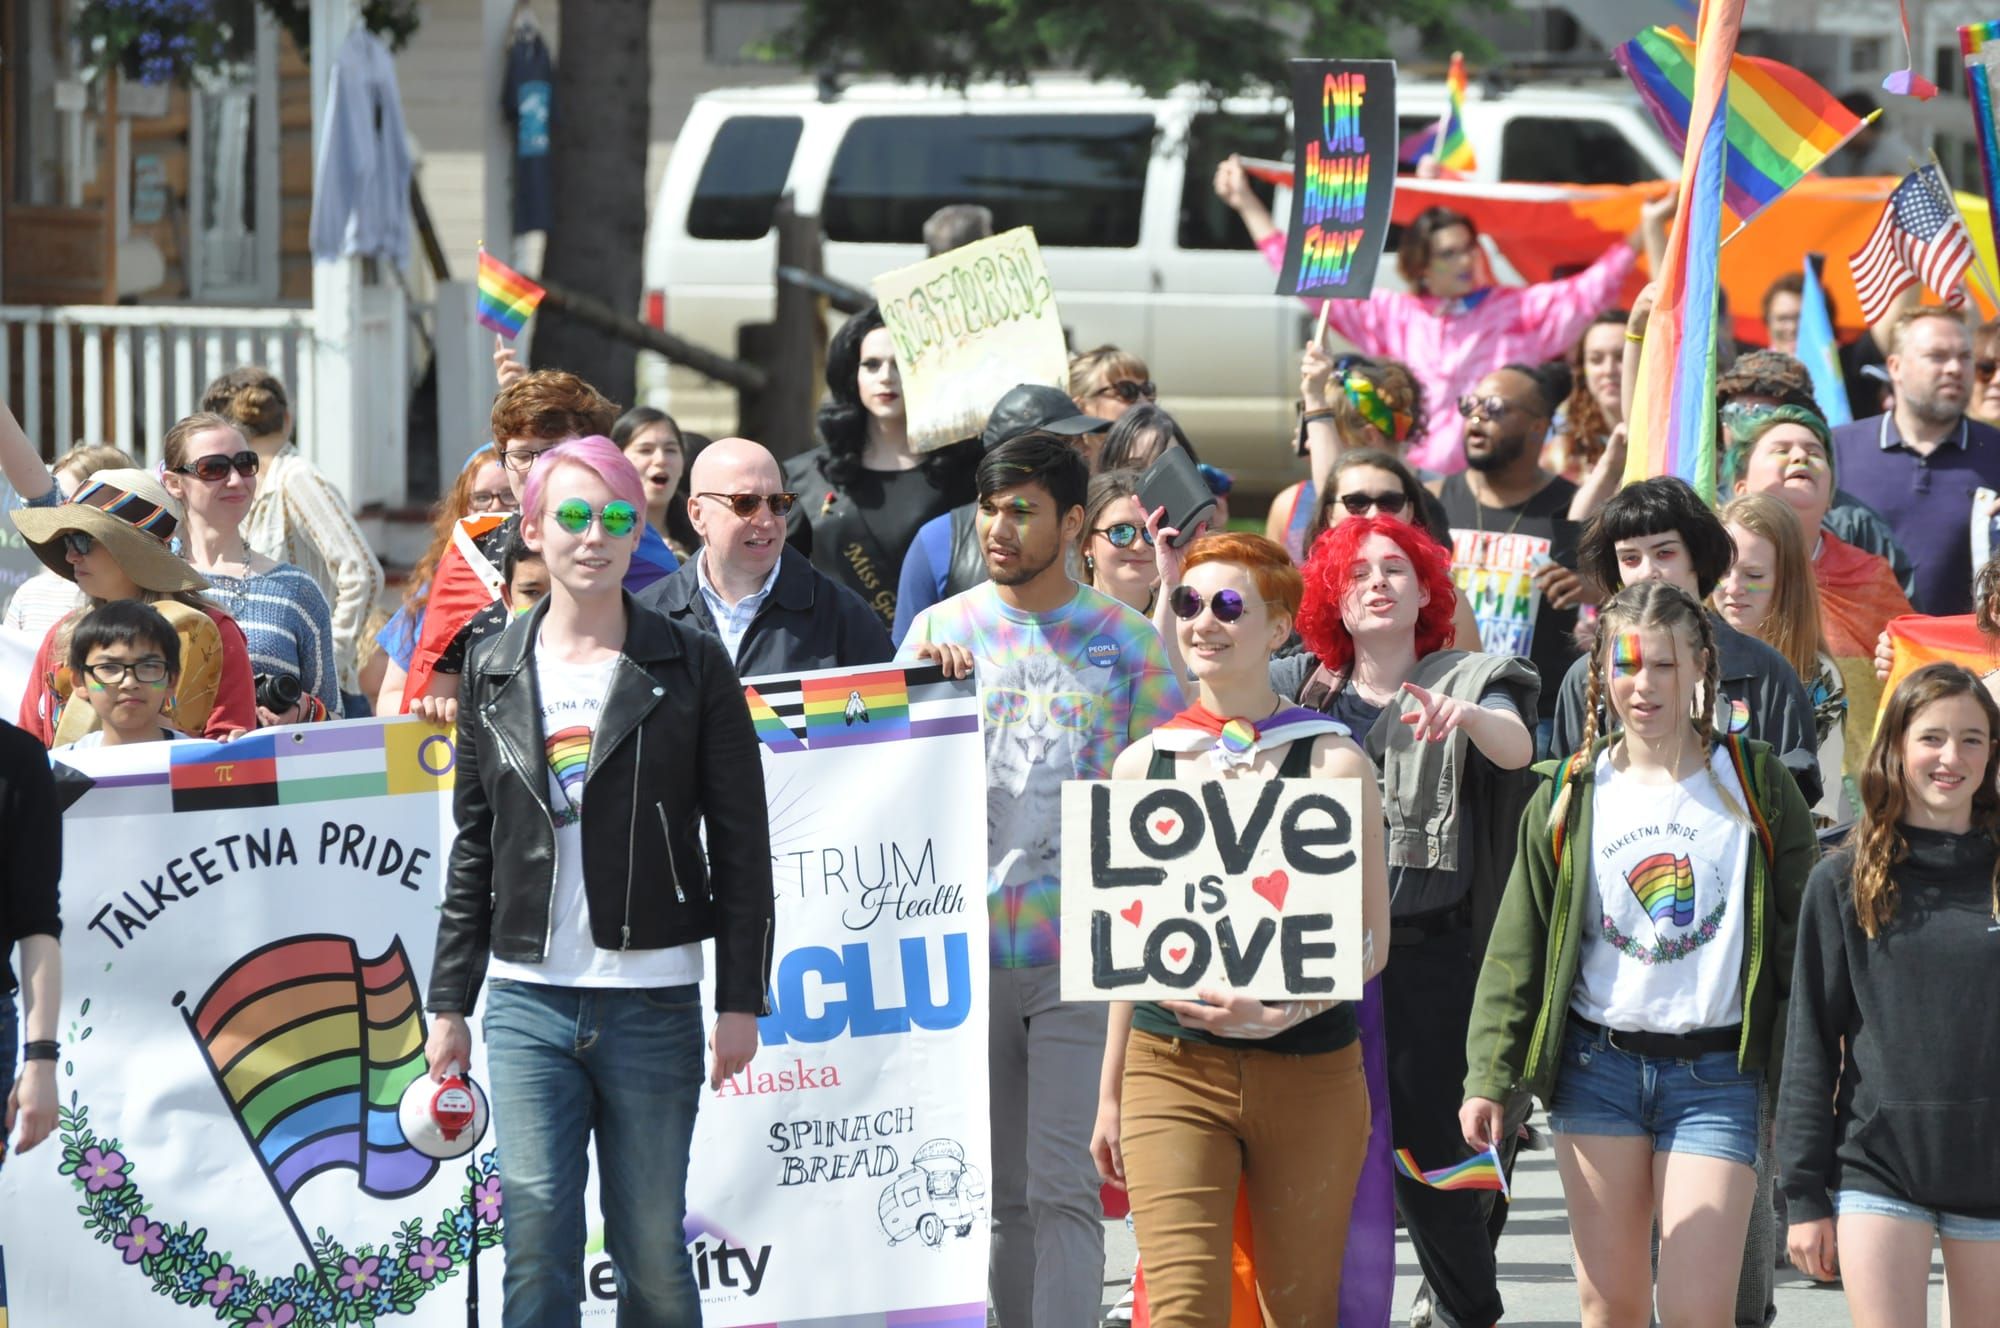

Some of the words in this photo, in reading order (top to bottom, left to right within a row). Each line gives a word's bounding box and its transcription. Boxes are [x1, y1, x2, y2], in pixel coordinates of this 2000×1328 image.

[1323, 72, 1366, 153] ONE
[1302, 140, 1370, 224] HUMAN
[1295, 224, 1364, 293] FAMILY
[842, 543, 880, 589] Miss
[770, 838, 936, 900] TRUM
[1601, 825, 1660, 860] TALKEETNA
[1666, 823, 1698, 841] PRIDE
[87, 828, 297, 949] TALKEETNA
[319, 822, 431, 891] PRIDE
[842, 881, 967, 930] Health
[1091, 910, 1336, 994] LOVE
[715, 1058, 841, 1098] Alaska
[767, 1106, 914, 1153] SPINACH
[776, 1145, 899, 1186] BREAD
